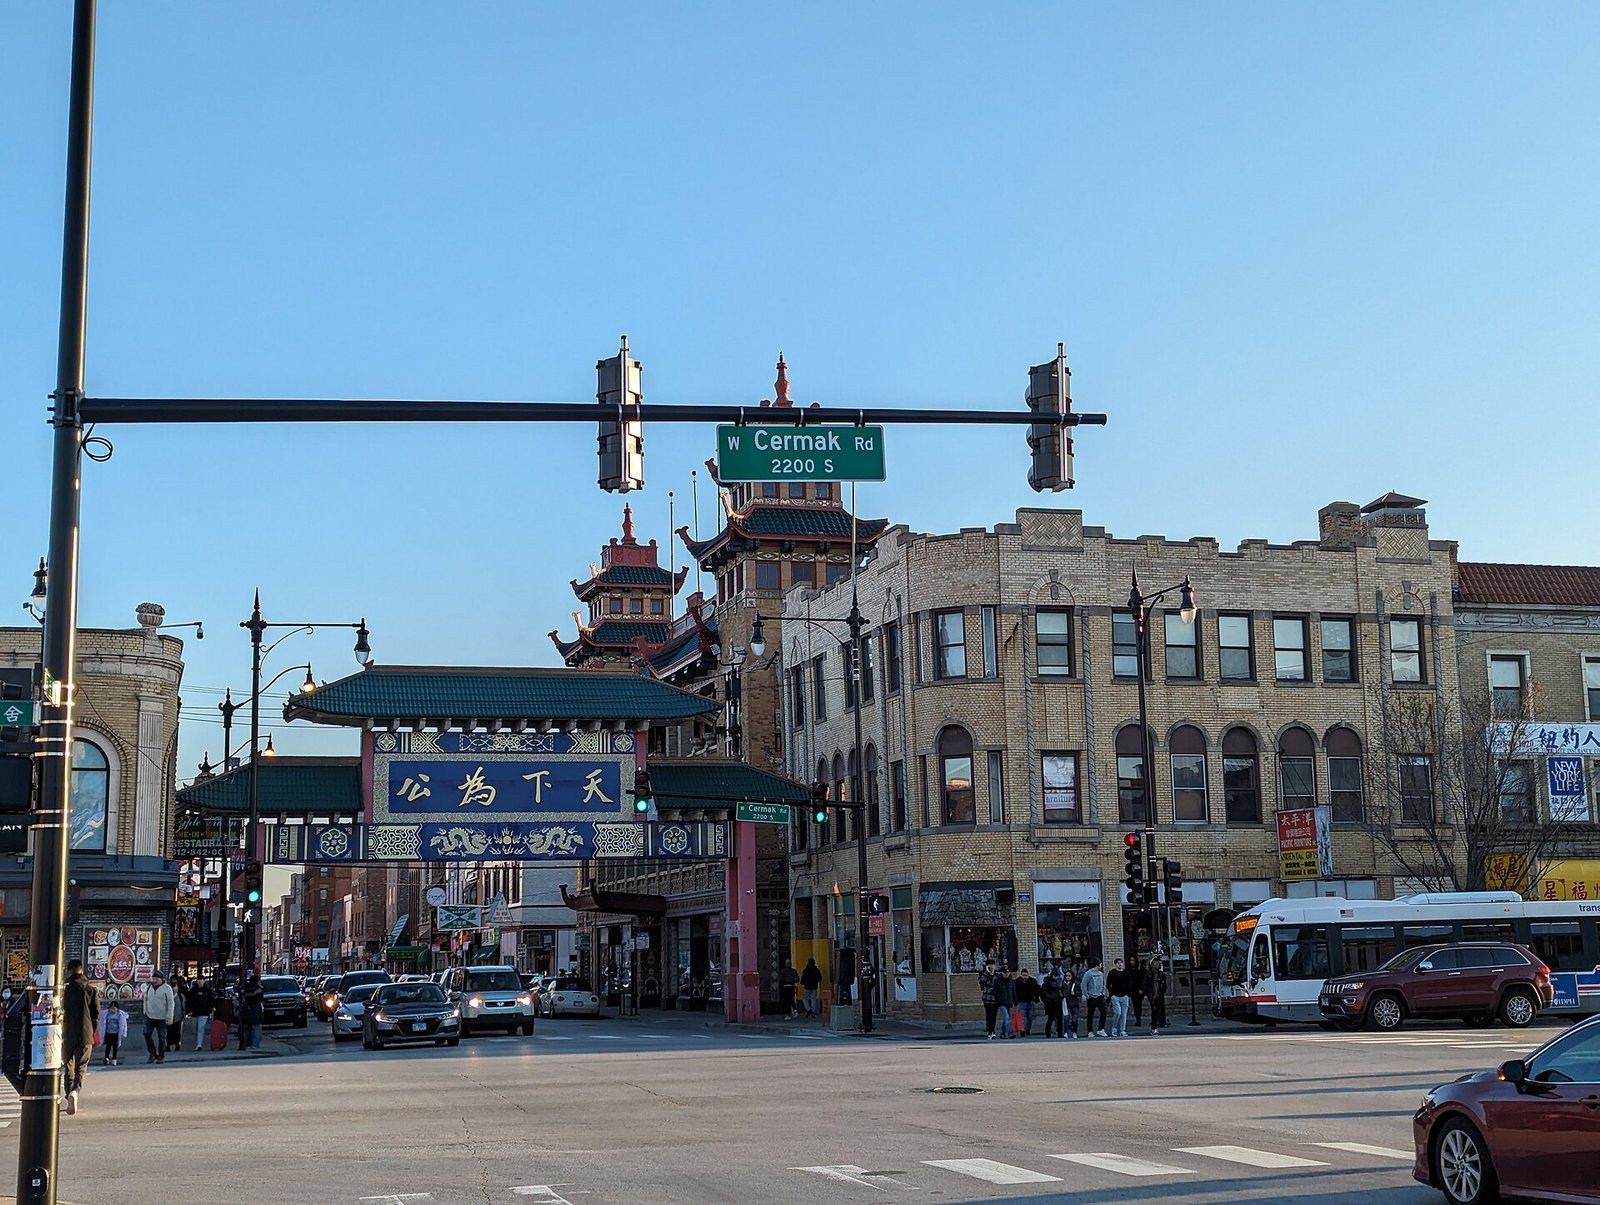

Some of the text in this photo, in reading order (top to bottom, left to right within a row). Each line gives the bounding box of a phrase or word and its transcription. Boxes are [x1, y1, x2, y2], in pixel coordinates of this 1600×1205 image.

[728, 430, 874, 451] W Cermak Rd
[771, 459, 834, 473] 2200 S
[1554, 761, 1578, 771] NEW
[1551, 770, 1580, 780] YORK
[1556, 780, 1580, 791] LIFE
[748, 804, 777, 813] Cermak
[1281, 812, 1313, 827] 太平洋
